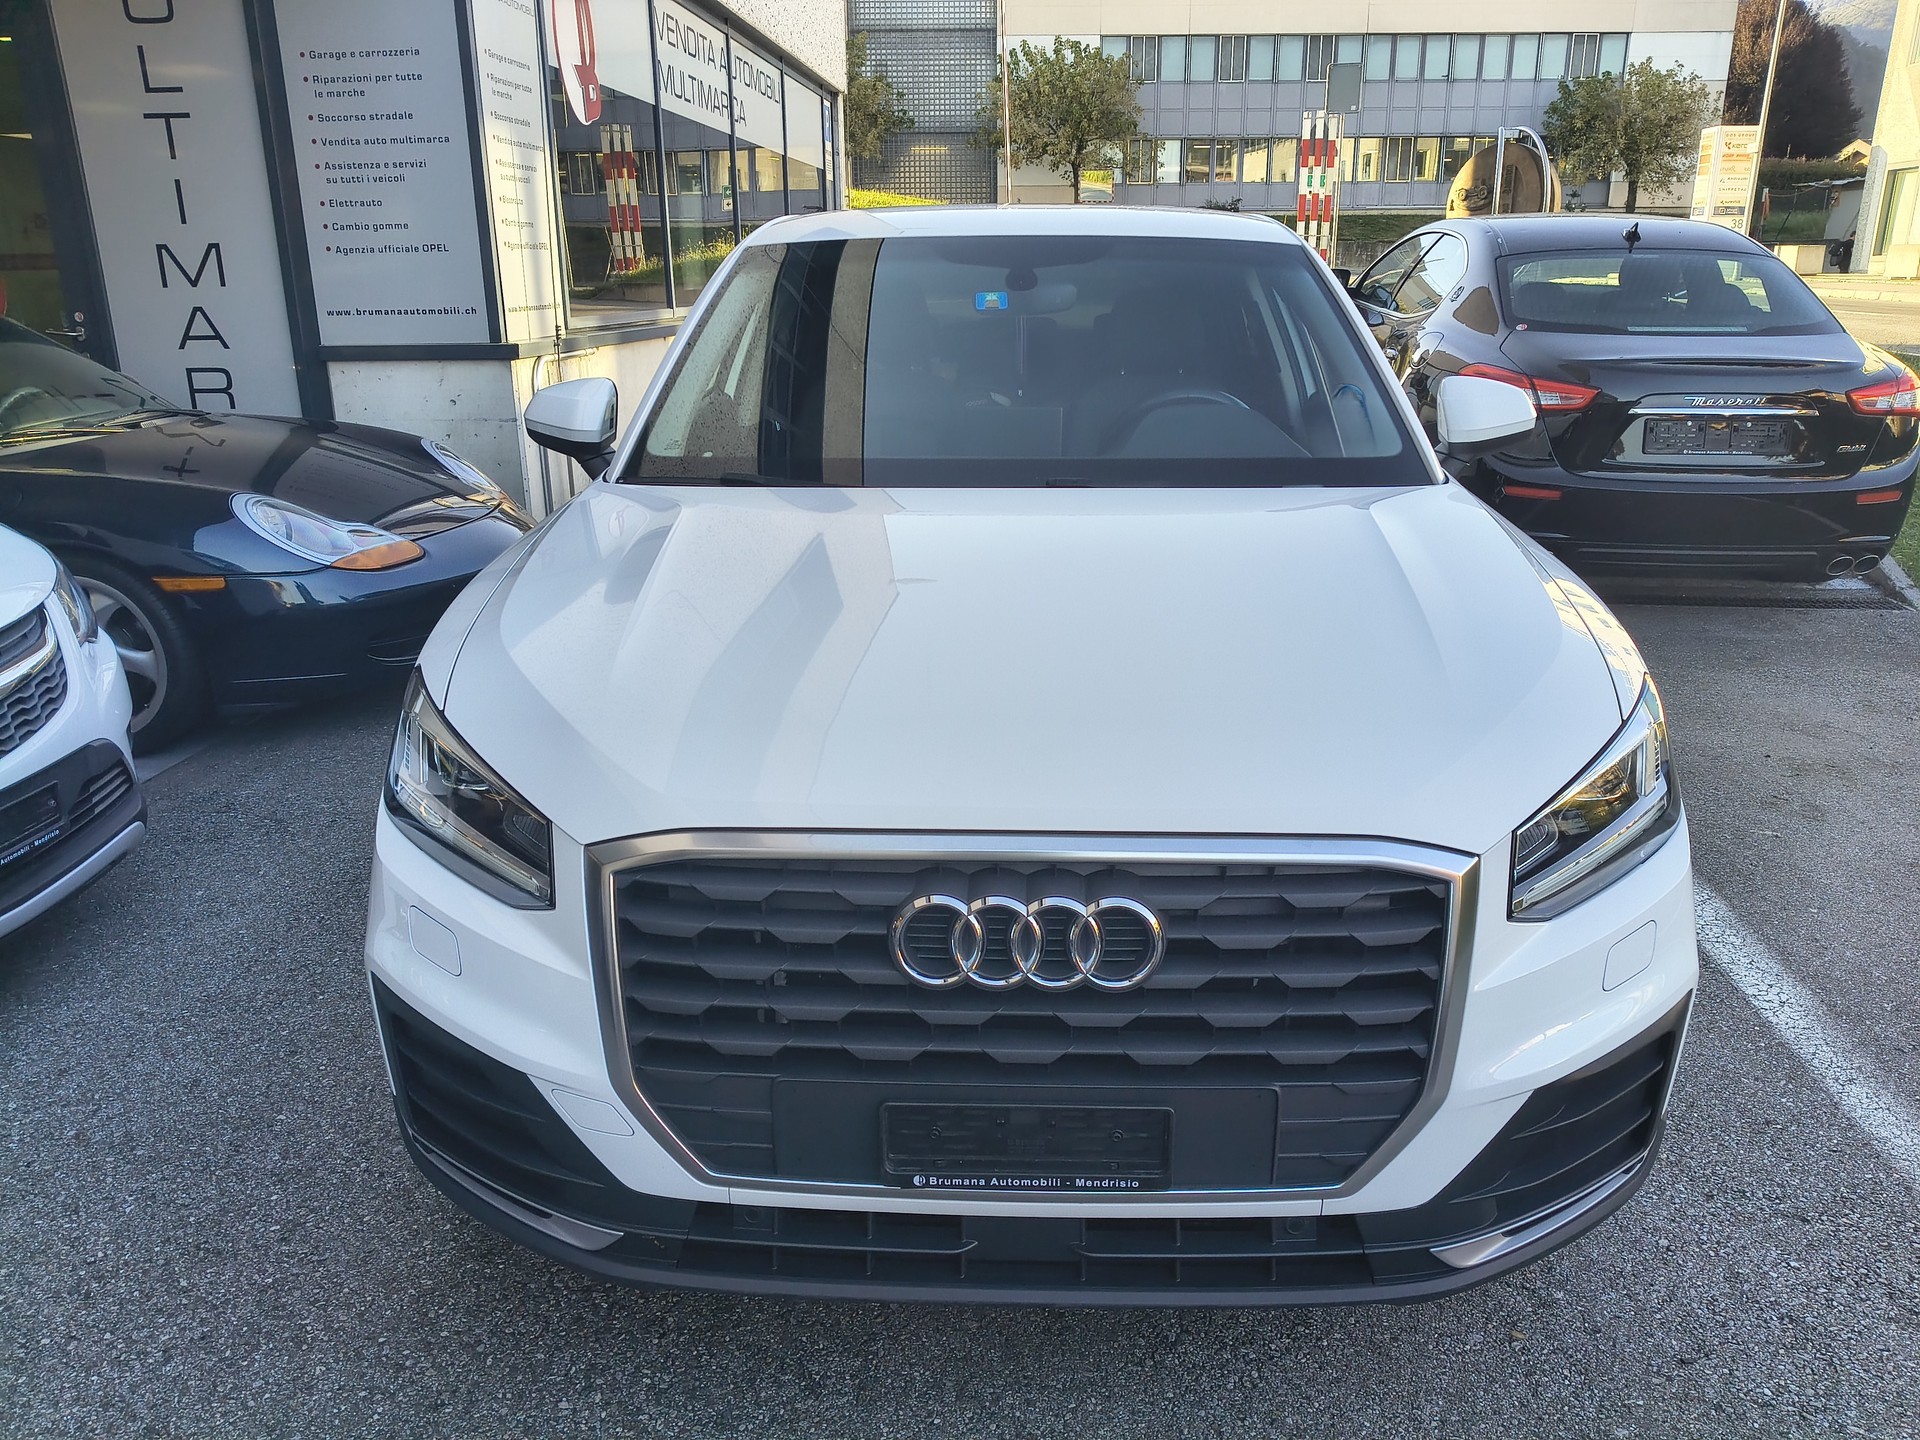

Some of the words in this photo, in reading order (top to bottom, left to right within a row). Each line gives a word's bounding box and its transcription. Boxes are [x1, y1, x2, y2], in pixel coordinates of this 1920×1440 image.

[309, 49, 347, 61] Garage
[358, 47, 420, 58] carrozzeria
[653, 5, 716, 70] VENDITA
[719, 46, 780, 104] AUTOMOBILI
[312, 73, 372, 85] Riparazioni
[375, 74, 393, 84] per
[395, 72, 423, 82] tutte
[314, 89, 323, 98] le
[326, 88, 365, 98] marche
[657, 59, 747, 127] MULTIMARCA
[317, 113, 366, 122] Soccorso
[369, 111, 413, 121] stradale
[320, 136, 360, 146] Vendita
[363, 137, 387, 146] auto
[390, 134, 450, 144] multimarca
[324, 160, 381, 171] Assistenza
[384, 162, 390, 170] e
[392, 159, 427, 169] servizi
[326, 176, 338, 184] su
[340, 175, 365, 184] tutti
[373, 173, 405, 183] veicoli
[329, 198, 382, 208] Elettrauto
[332, 222, 370, 231] Cambio
[372, 222, 409, 233] gomme
[1730, 218, 1744, 229] 38
[335, 245, 375, 256] Agenzia
[378, 244, 420, 254] ufficiale
[422, 243, 449, 253] OPEL
[326, 307, 477, 318] www.brumanaautomobili.ch
[1684, 396, 1767, 407] Maserati
[0, 844, 30, 865] Automobili
[34, 829, 60, 847] Mendrisio
[929, 1176, 986, 1187] Brumana
[990, 1177, 1061, 1188] Automobili
[1075, 1178, 1140, 1189] Mendrisio
